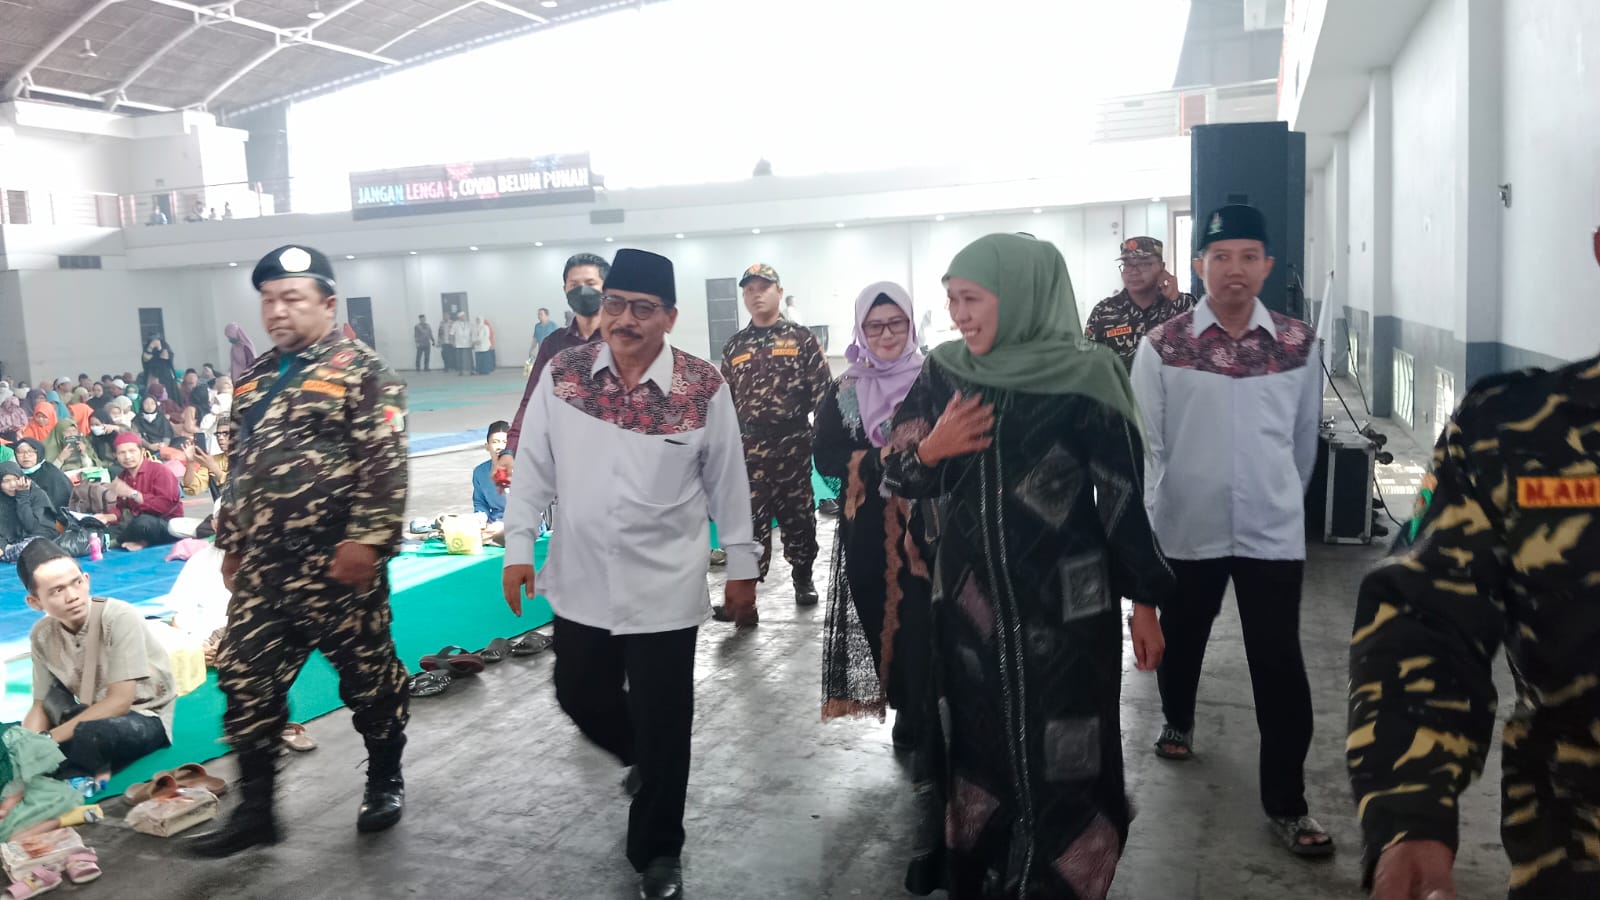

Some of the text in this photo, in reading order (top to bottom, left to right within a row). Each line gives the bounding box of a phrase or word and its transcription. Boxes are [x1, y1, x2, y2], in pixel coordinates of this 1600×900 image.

[357, 167, 588, 204] JANGAN LENGAH, COVID BELUM PUNAH
